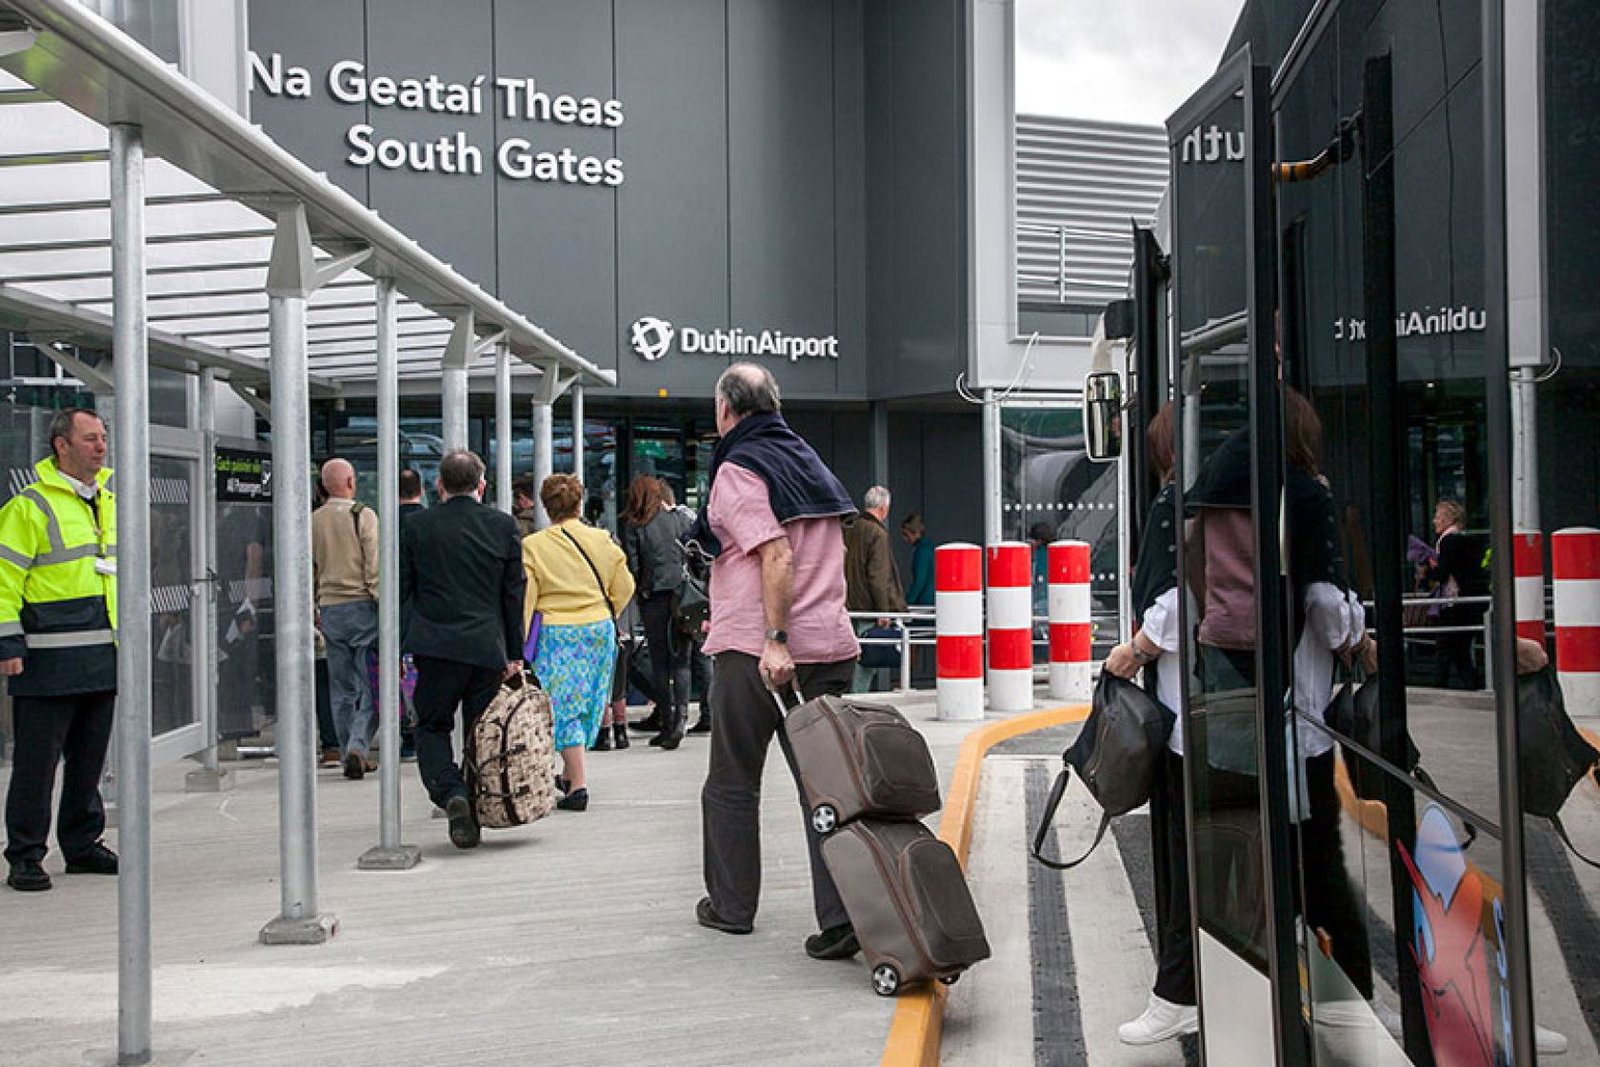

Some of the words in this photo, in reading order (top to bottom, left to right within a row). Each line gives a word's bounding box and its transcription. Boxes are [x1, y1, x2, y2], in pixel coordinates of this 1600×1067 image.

[247, 51, 311, 97] Na
[329, 60, 486, 114] Geataí
[497, 76, 625, 128] Theas
[348, 123, 483, 174] South
[498, 137, 625, 186] Gates
[681, 327, 839, 362] DublinAirport
